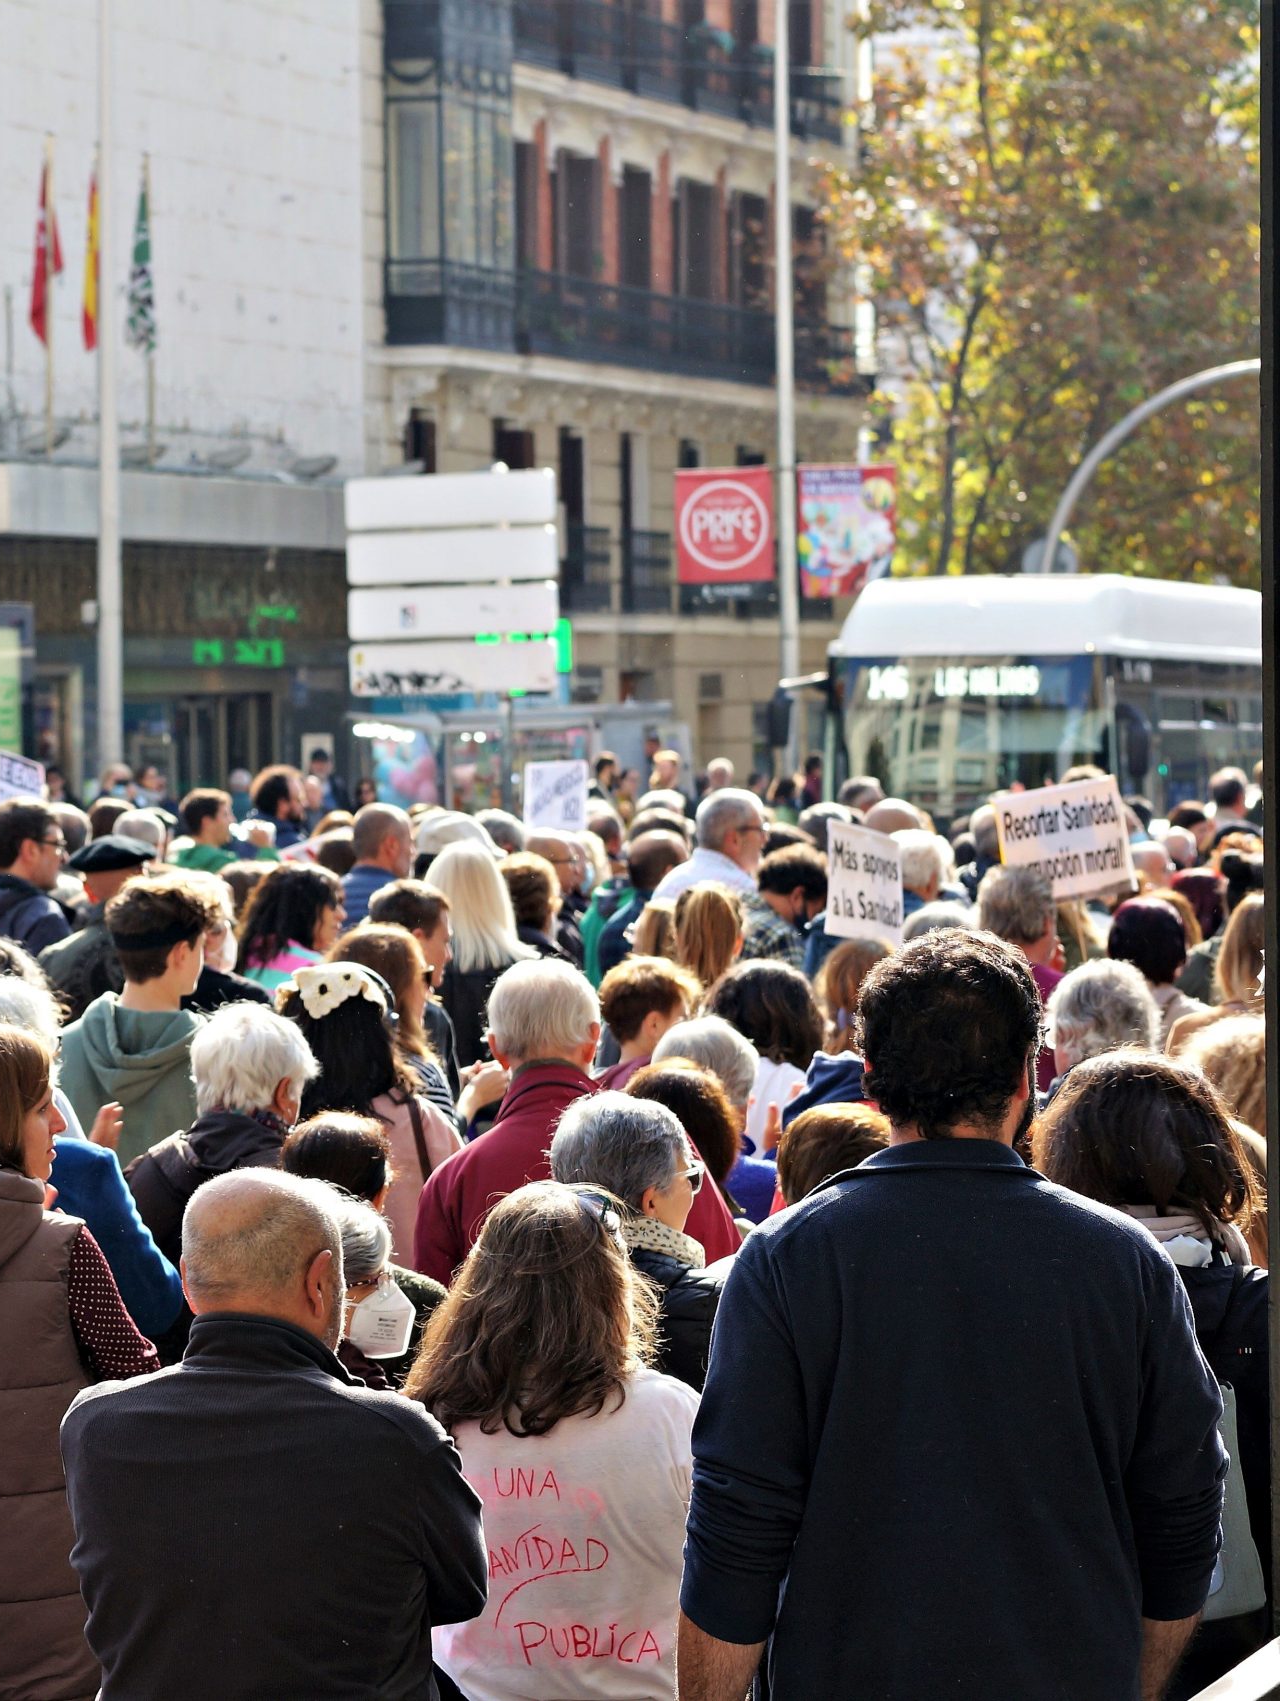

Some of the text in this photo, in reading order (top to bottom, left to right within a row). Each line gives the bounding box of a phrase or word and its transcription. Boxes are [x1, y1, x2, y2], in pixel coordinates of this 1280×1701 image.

[1003, 804, 1060, 842] Recortar
[831, 839, 898, 885] Más apoyos
[833, 896, 840, 916] a
[842, 888, 854, 918] la
[494, 1467, 561, 1501] UNA
[514, 1621, 661, 1666] PUBLICA
